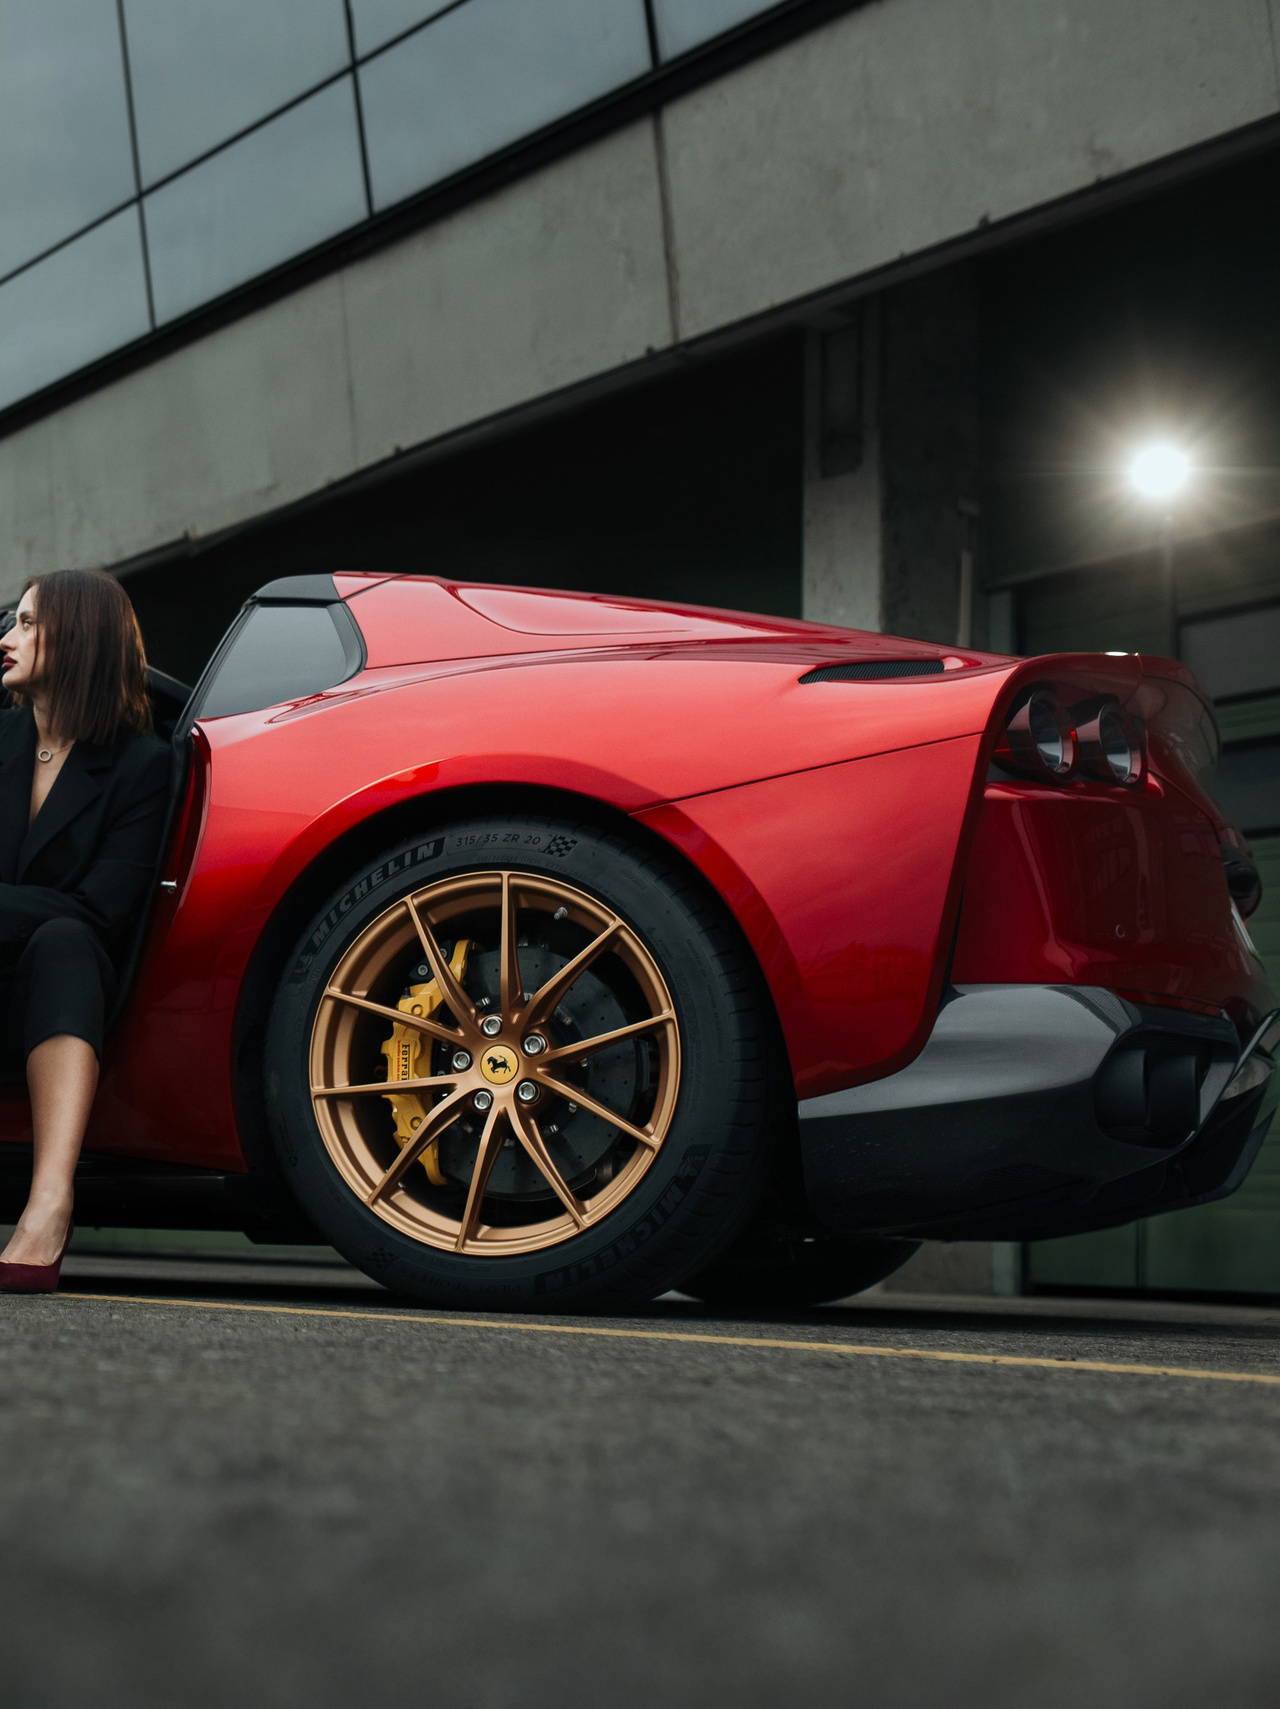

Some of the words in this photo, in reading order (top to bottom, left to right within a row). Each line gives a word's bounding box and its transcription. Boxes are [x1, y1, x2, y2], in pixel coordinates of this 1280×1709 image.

[456, 833, 498, 847] 315/35
[503, 833, 519, 843] ZR
[524, 834, 541, 845] 20
[311, 841, 436, 947] MICHELIN
[401, 1043, 410, 1081] Ferra
[544, 1183, 683, 1294] MICHELIN
